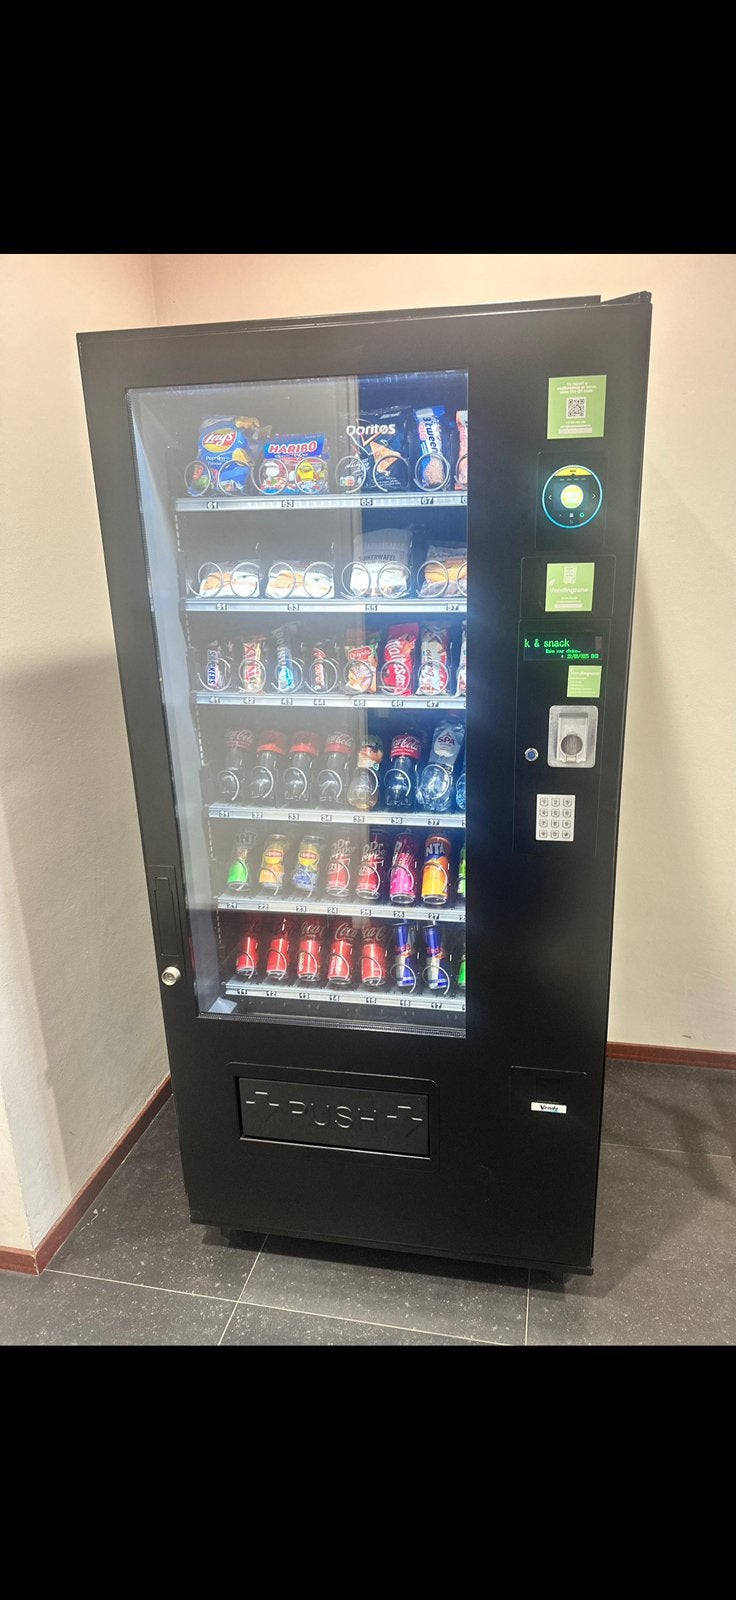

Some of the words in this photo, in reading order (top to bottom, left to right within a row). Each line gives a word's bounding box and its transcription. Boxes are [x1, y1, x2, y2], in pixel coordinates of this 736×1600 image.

[346, 423, 396, 436] Doritos
[268, 440, 318, 454] HARIBO
[282, 500, 294, 508] 63
[361, 498, 373, 506] 65
[524, 638, 530, 648] k
[534, 638, 540, 648] &
[543, 637, 570, 648] snack
[437, 736, 455, 746] SPA
[289, 1100, 378, 1131] PUSH
